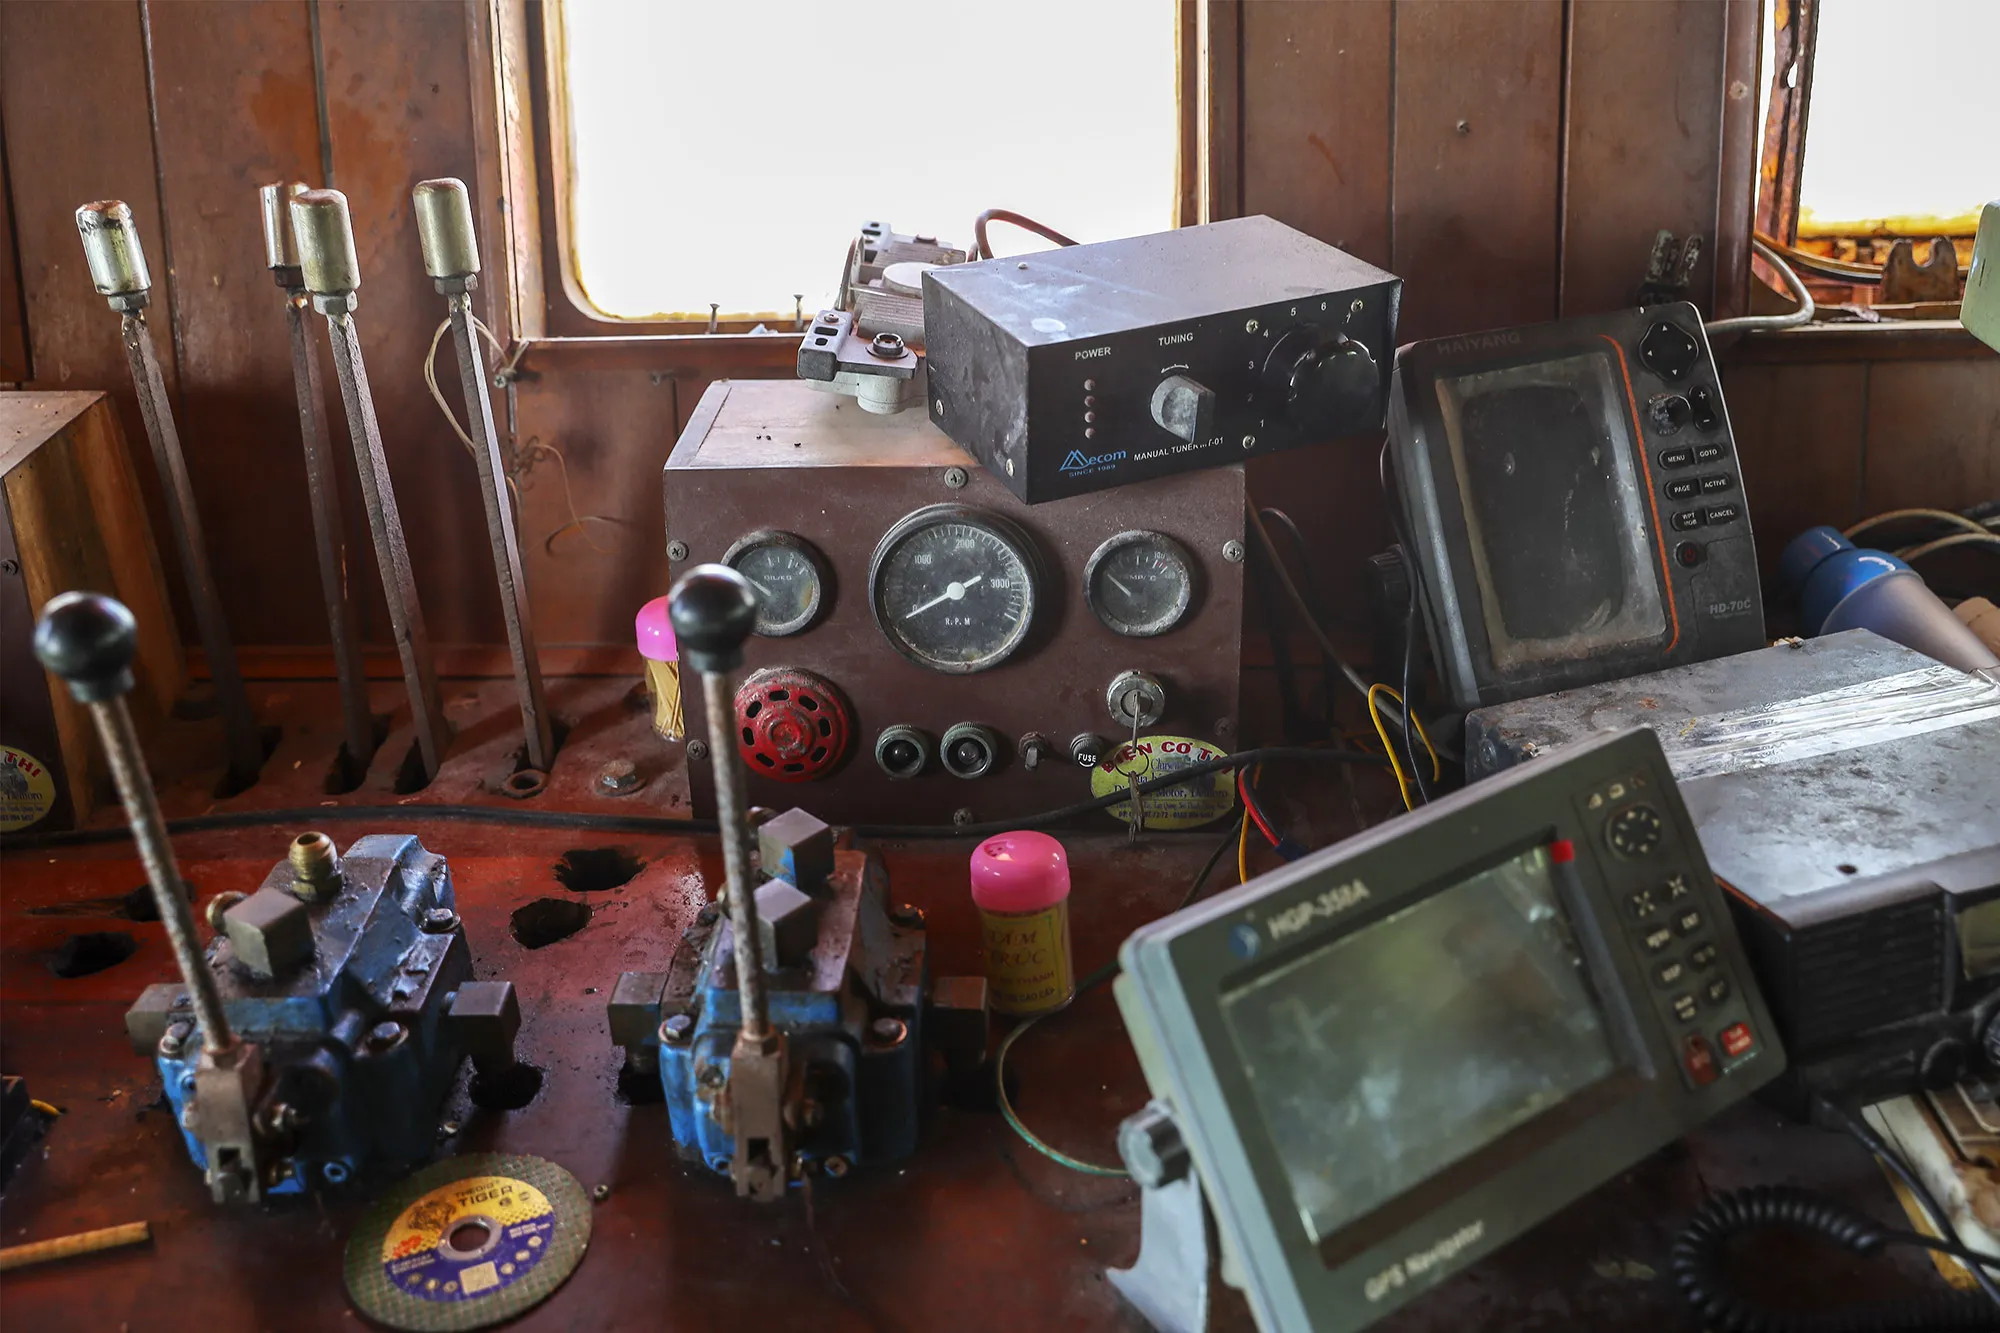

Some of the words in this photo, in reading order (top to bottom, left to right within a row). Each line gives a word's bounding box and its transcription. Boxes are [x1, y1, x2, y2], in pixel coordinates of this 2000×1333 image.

[1321, 302, 1327, 310] 6
[1290, 307, 1296, 316] 5
[1263, 329, 1269, 338] 4
[1158, 332, 1194, 346] TUNING
[1437, 333, 1521, 355] HAIYANG
[1075, 347, 1111, 360] POWER
[1248, 361, 1254, 369] 3
[1134, 449, 1169, 461] MANUAL
[1171, 443, 1199, 454] TUNER
[1700, 449, 1718, 457] GOTO
[1069, 468, 1094, 478] SINCE
[1704, 479, 1727, 488] ACTIVE
[1674, 485, 1691, 493] PAGE
[1709, 509, 1735, 519] CANCEL
[956, 539, 975, 549] 2000
[914, 554, 932, 565] 1000
[990, 578, 1011, 589] 3000
[1709, 599, 1751, 615] HD-70C
[1078, 752, 1097, 763] FUSE
[458, 1185, 513, 1207] TIGER
